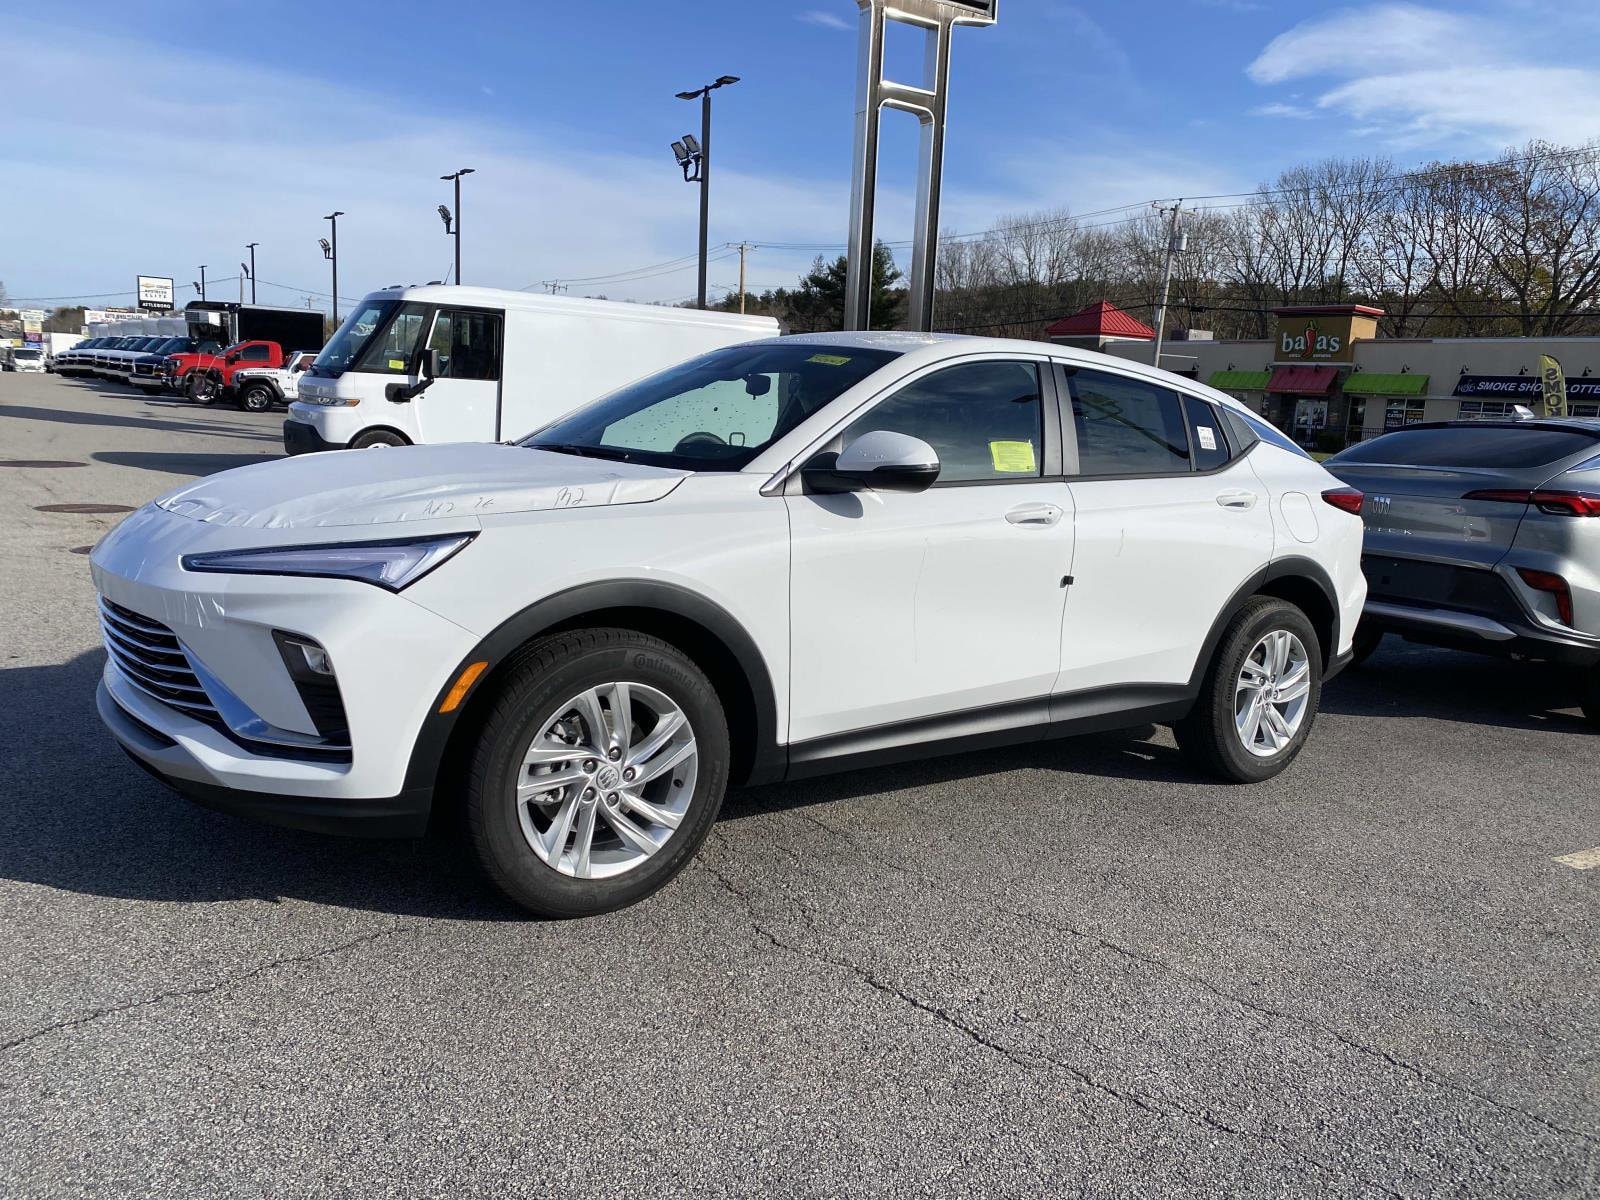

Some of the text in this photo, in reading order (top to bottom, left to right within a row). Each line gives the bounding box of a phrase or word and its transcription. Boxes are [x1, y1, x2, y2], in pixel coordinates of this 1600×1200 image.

[1476, 381, 1517, 391] SMOKE
[1518, 382, 1543, 392] SHO
[632, 652, 698, 690] Continental
